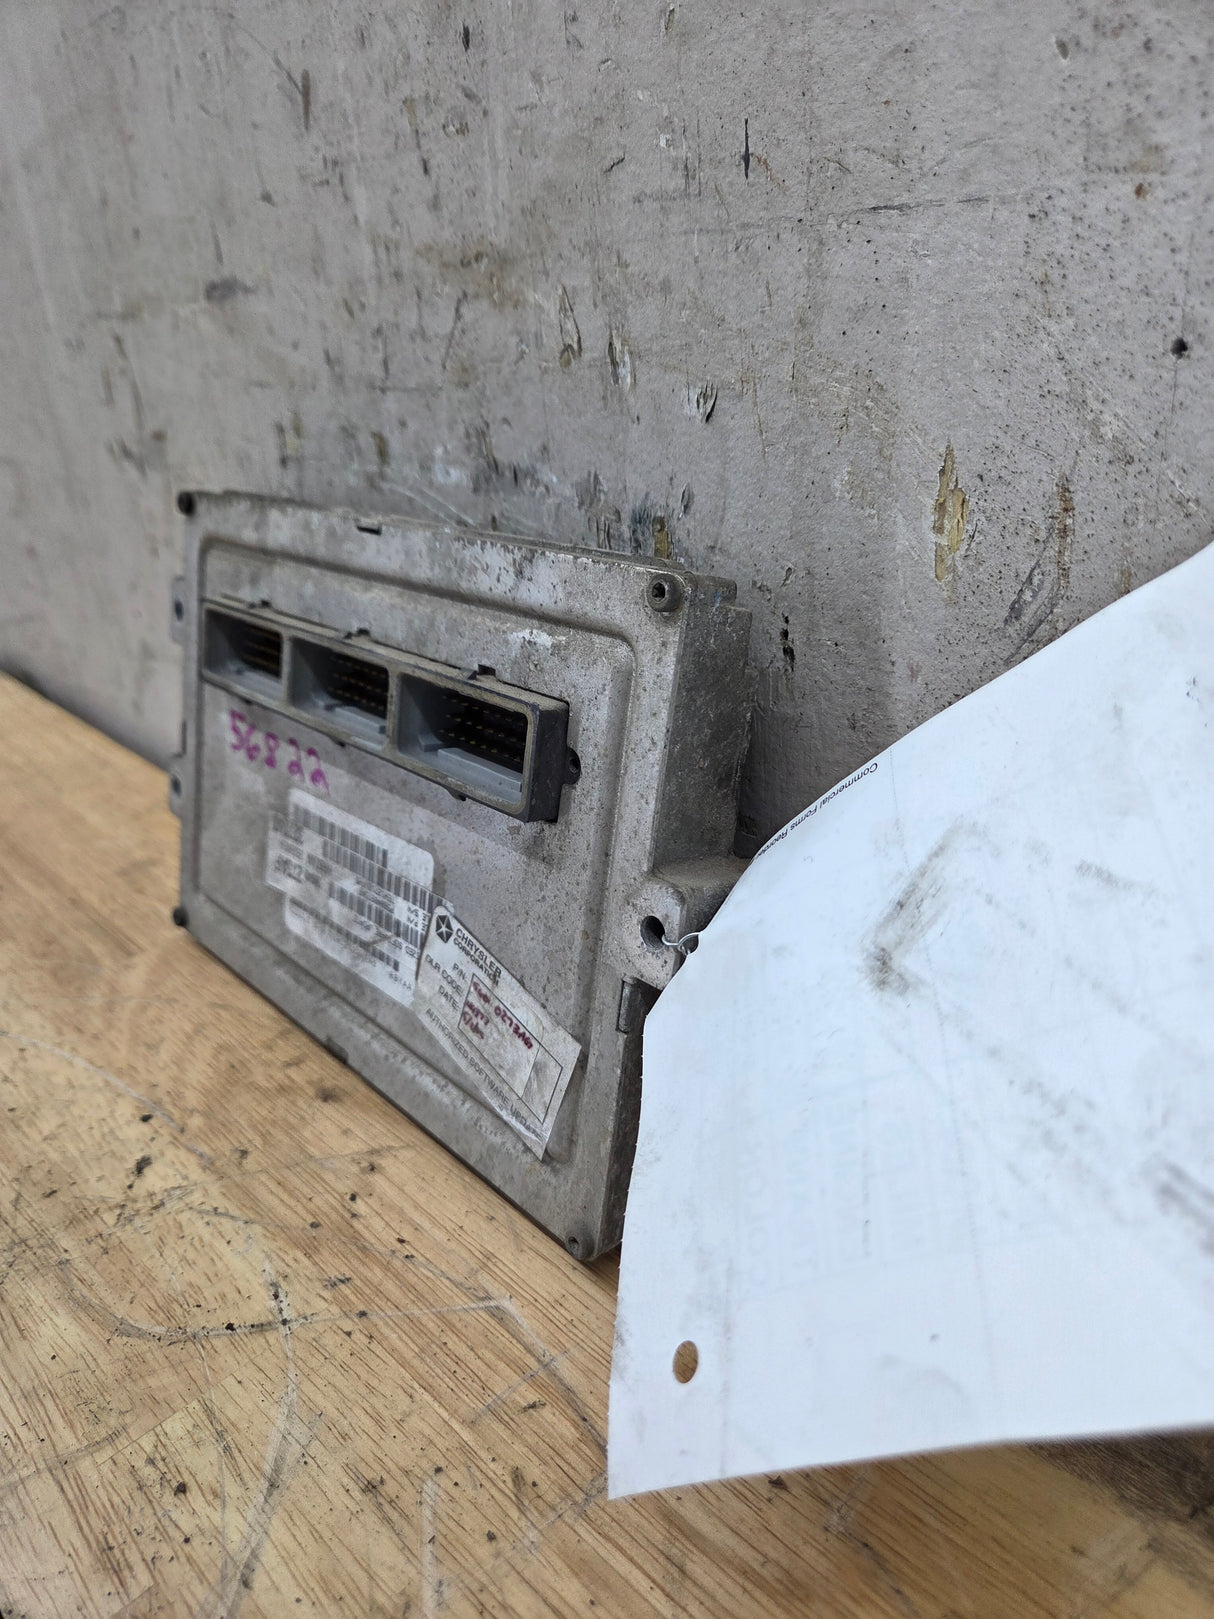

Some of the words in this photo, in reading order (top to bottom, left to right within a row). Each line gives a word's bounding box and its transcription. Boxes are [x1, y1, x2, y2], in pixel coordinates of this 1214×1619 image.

[820, 762, 878, 808] Commercial
[790, 805, 818, 830] Forms
[453, 938, 500, 987] CORPORATION
[455, 927, 502, 977] CHRYSLER
[426, 1008, 469, 1061] AUTHORIZED
[470, 1058, 510, 1106] SOFTWARE
